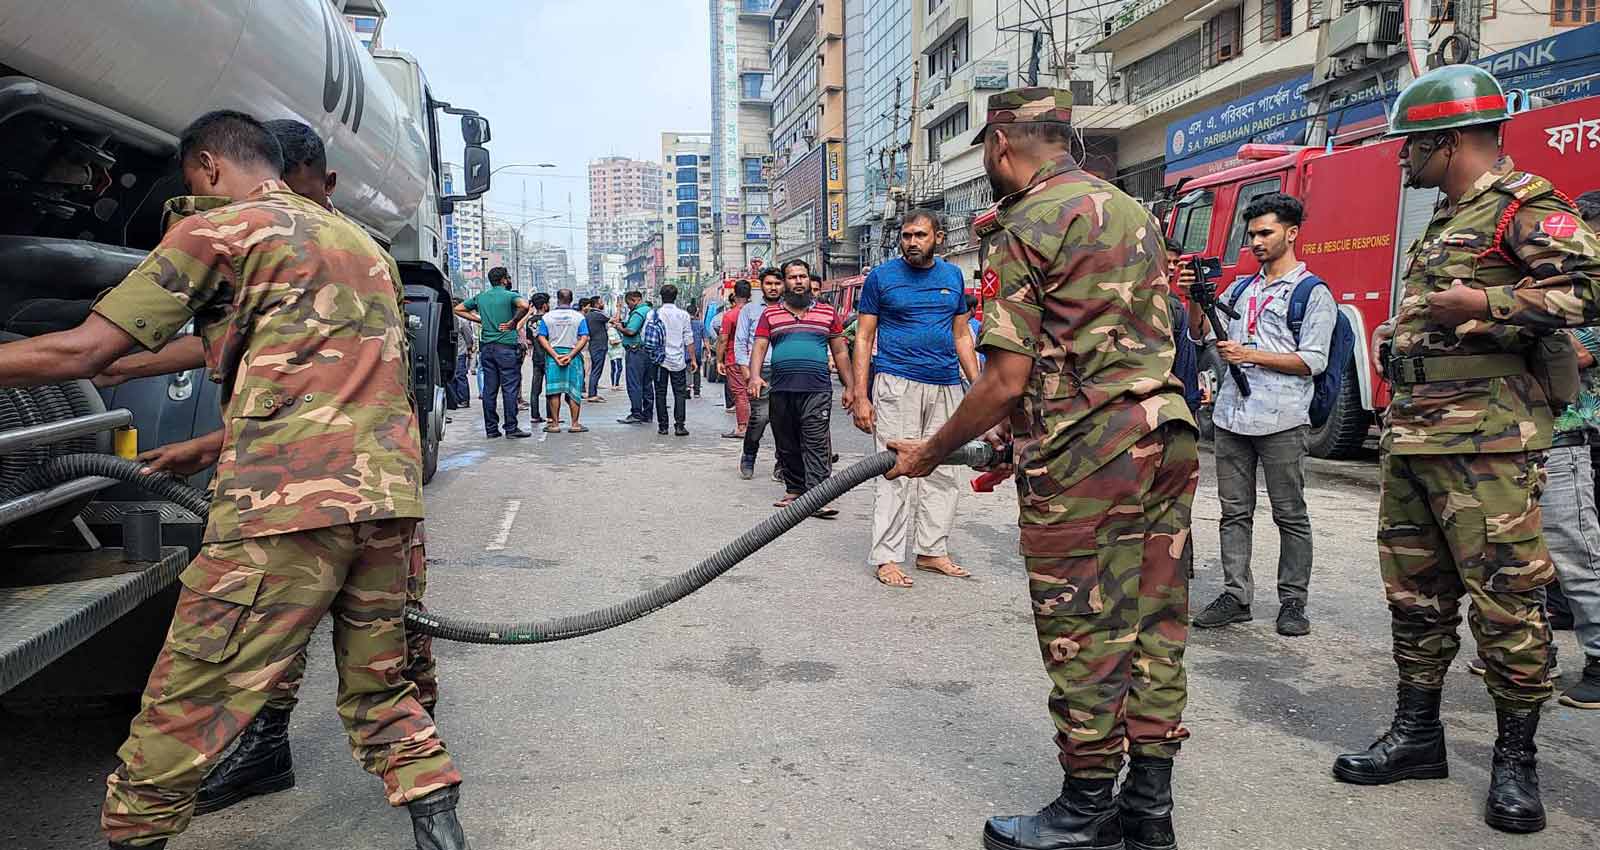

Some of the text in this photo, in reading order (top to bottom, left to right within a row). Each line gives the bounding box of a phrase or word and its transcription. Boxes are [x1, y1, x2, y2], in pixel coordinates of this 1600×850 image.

[322, 0, 364, 134] UN
[1203, 124, 1250, 145] PARIBAHAN
[1251, 112, 1287, 134] PARCEL
[1289, 109, 1297, 120] &
[1220, 104, 1256, 126] পরিবহন
[1302, 242, 1316, 256] FIRE
[1324, 238, 1350, 254] RESCUE
[1352, 233, 1391, 250] RESPONSE
